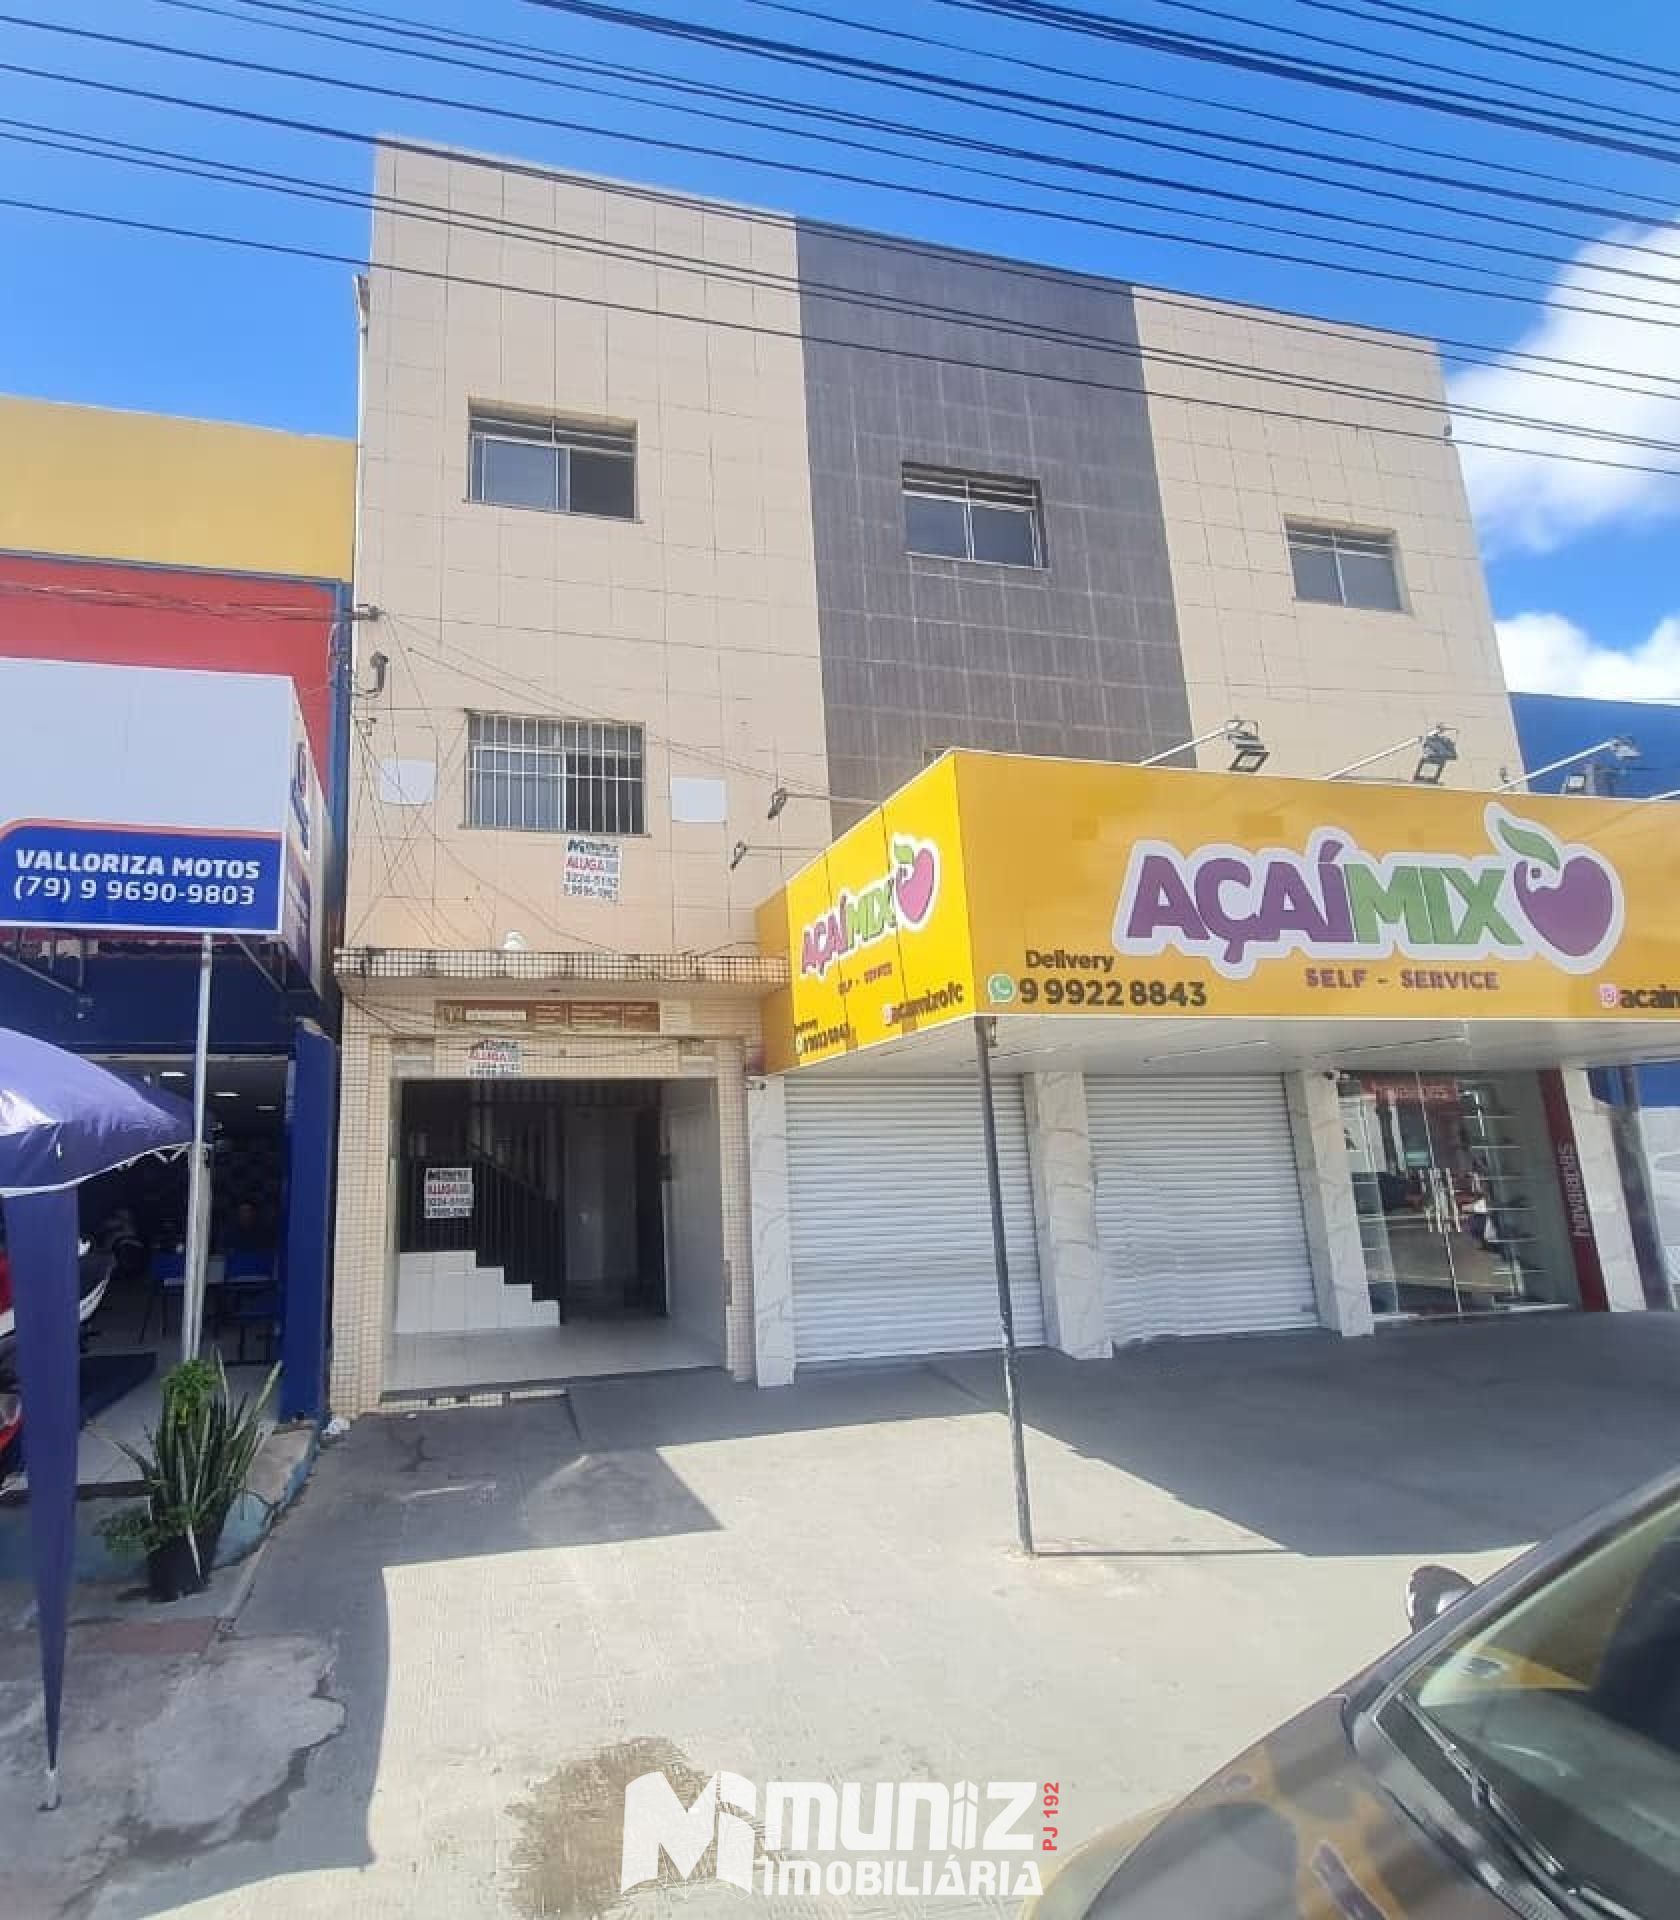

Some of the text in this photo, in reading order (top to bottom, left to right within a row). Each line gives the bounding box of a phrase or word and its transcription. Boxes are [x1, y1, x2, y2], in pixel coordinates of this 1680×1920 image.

[16, 849, 260, 879] VALLORIZA MOTOS
[14, 876, 255, 905] (79) 9 9690-9803
[1025, 949, 1114, 972] Delivery
[1019, 978, 1208, 1007] 9 9922 8843
[1305, 967, 1368, 989] SELF
[1400, 969, 1500, 990] SERVICE
